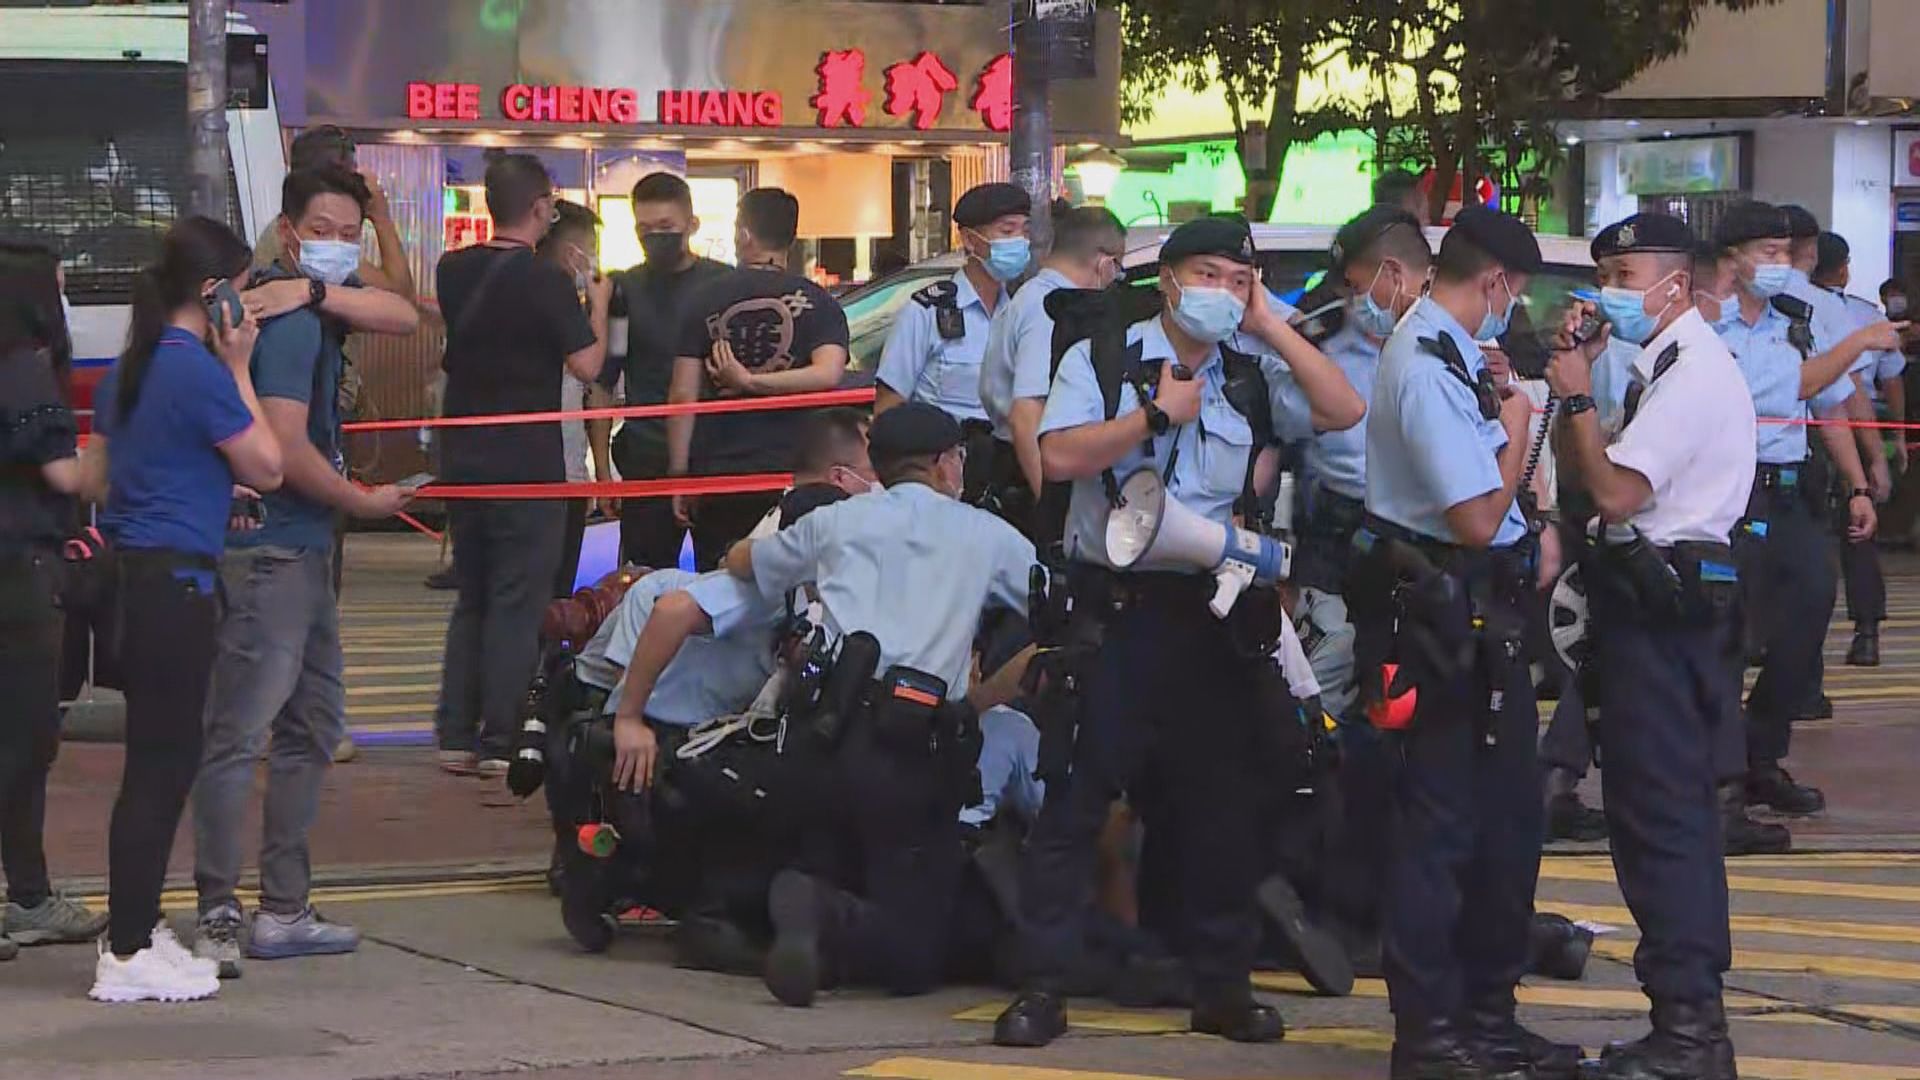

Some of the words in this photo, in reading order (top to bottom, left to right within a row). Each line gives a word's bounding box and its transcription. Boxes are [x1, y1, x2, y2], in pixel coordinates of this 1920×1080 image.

[408, 82, 480, 119] BEE
[504, 84, 638, 124] CHENG
[659, 89, 783, 127] HIANG
